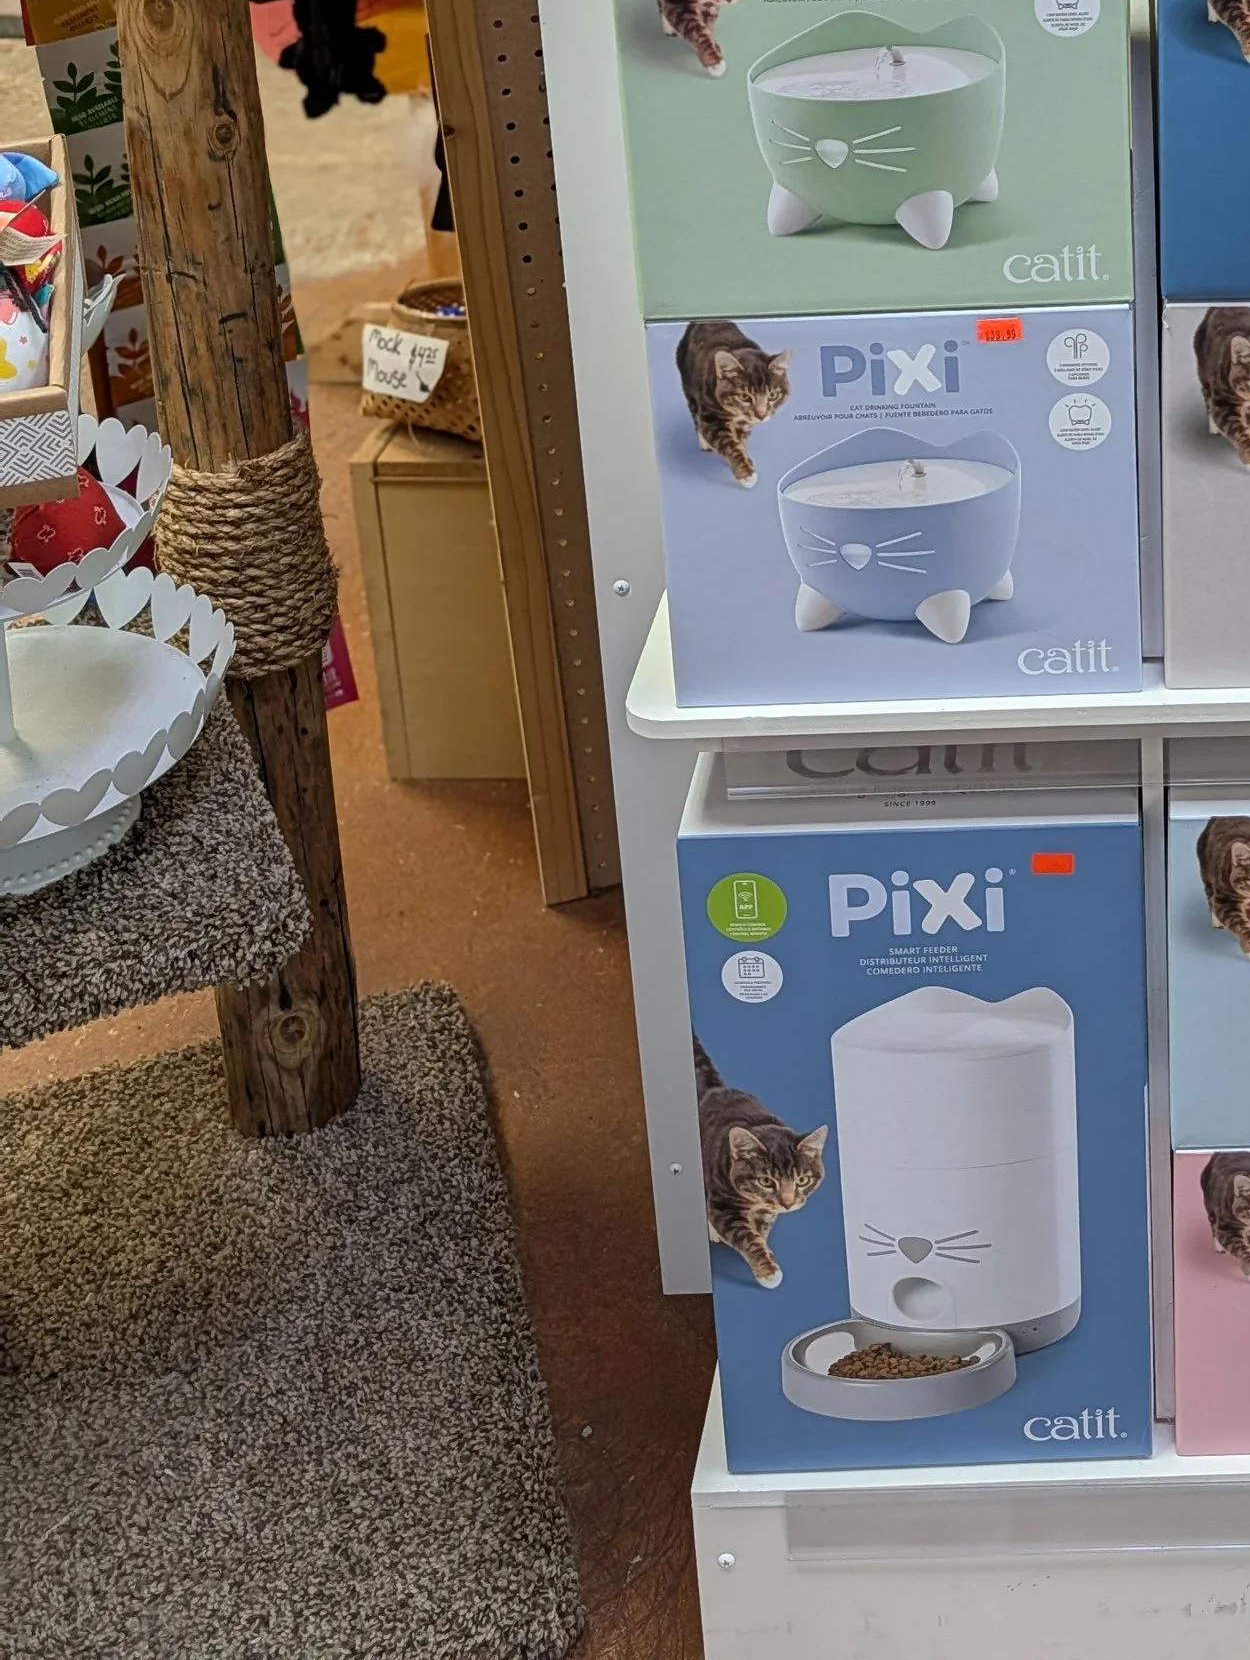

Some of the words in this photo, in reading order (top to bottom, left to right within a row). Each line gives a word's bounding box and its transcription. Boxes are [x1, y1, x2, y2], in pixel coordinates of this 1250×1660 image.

[1003, 244, 1103, 284] catit
[369, 328, 403, 355] Mock
[367, 358, 407, 389] Mouse
[820, 340, 960, 398] Pixi
[1017, 639, 1112, 676] catit
[829, 867, 1005, 938] Pixi
[859, 956, 926, 966] DISTRIBUTEUR
[929, 954, 988, 963] INTELLIGENT
[889, 947, 920, 956] SMART
[923, 946, 958, 954] FEEDER
[866, 966, 920, 975] COMEDERO
[923, 964, 982, 972] INTELIGENTE
[1023, 1407, 1121, 1441] catit
